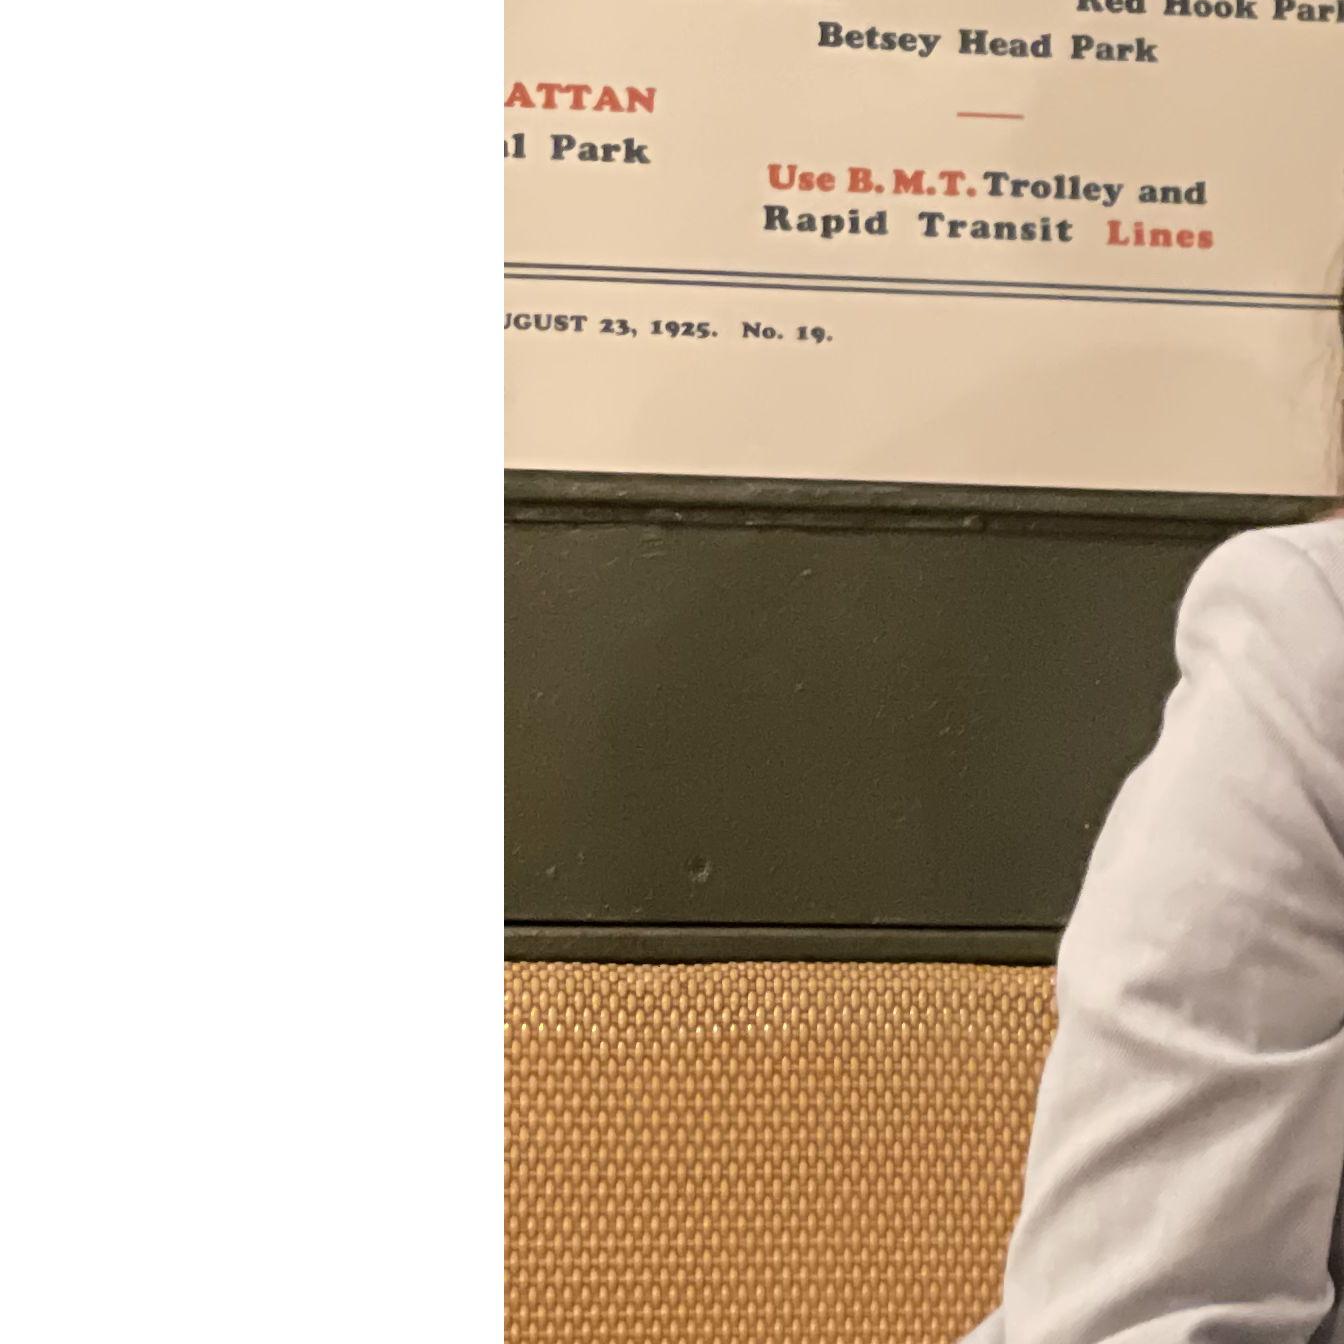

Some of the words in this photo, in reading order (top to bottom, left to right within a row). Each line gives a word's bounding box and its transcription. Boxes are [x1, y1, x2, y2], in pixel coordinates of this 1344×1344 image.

[817, 20, 943, 59] Betsey
[957, 27, 1054, 60] Head
[1069, 33, 1159, 64] Park
[549, 133, 652, 165] Park
[766, 162, 836, 193] Use
[982, 170, 1125, 208] Trolley
[1137, 180, 1208, 206] and
[762, 204, 889, 241] Rapid
[917, 210, 1074, 243] Transit
[1106, 218, 1214, 250] Lines
[598, 318, 638, 339] 23,
[650, 319, 719, 340] 1925.
[740, 320, 784, 340] No.
[796, 325, 833, 345] 19.
